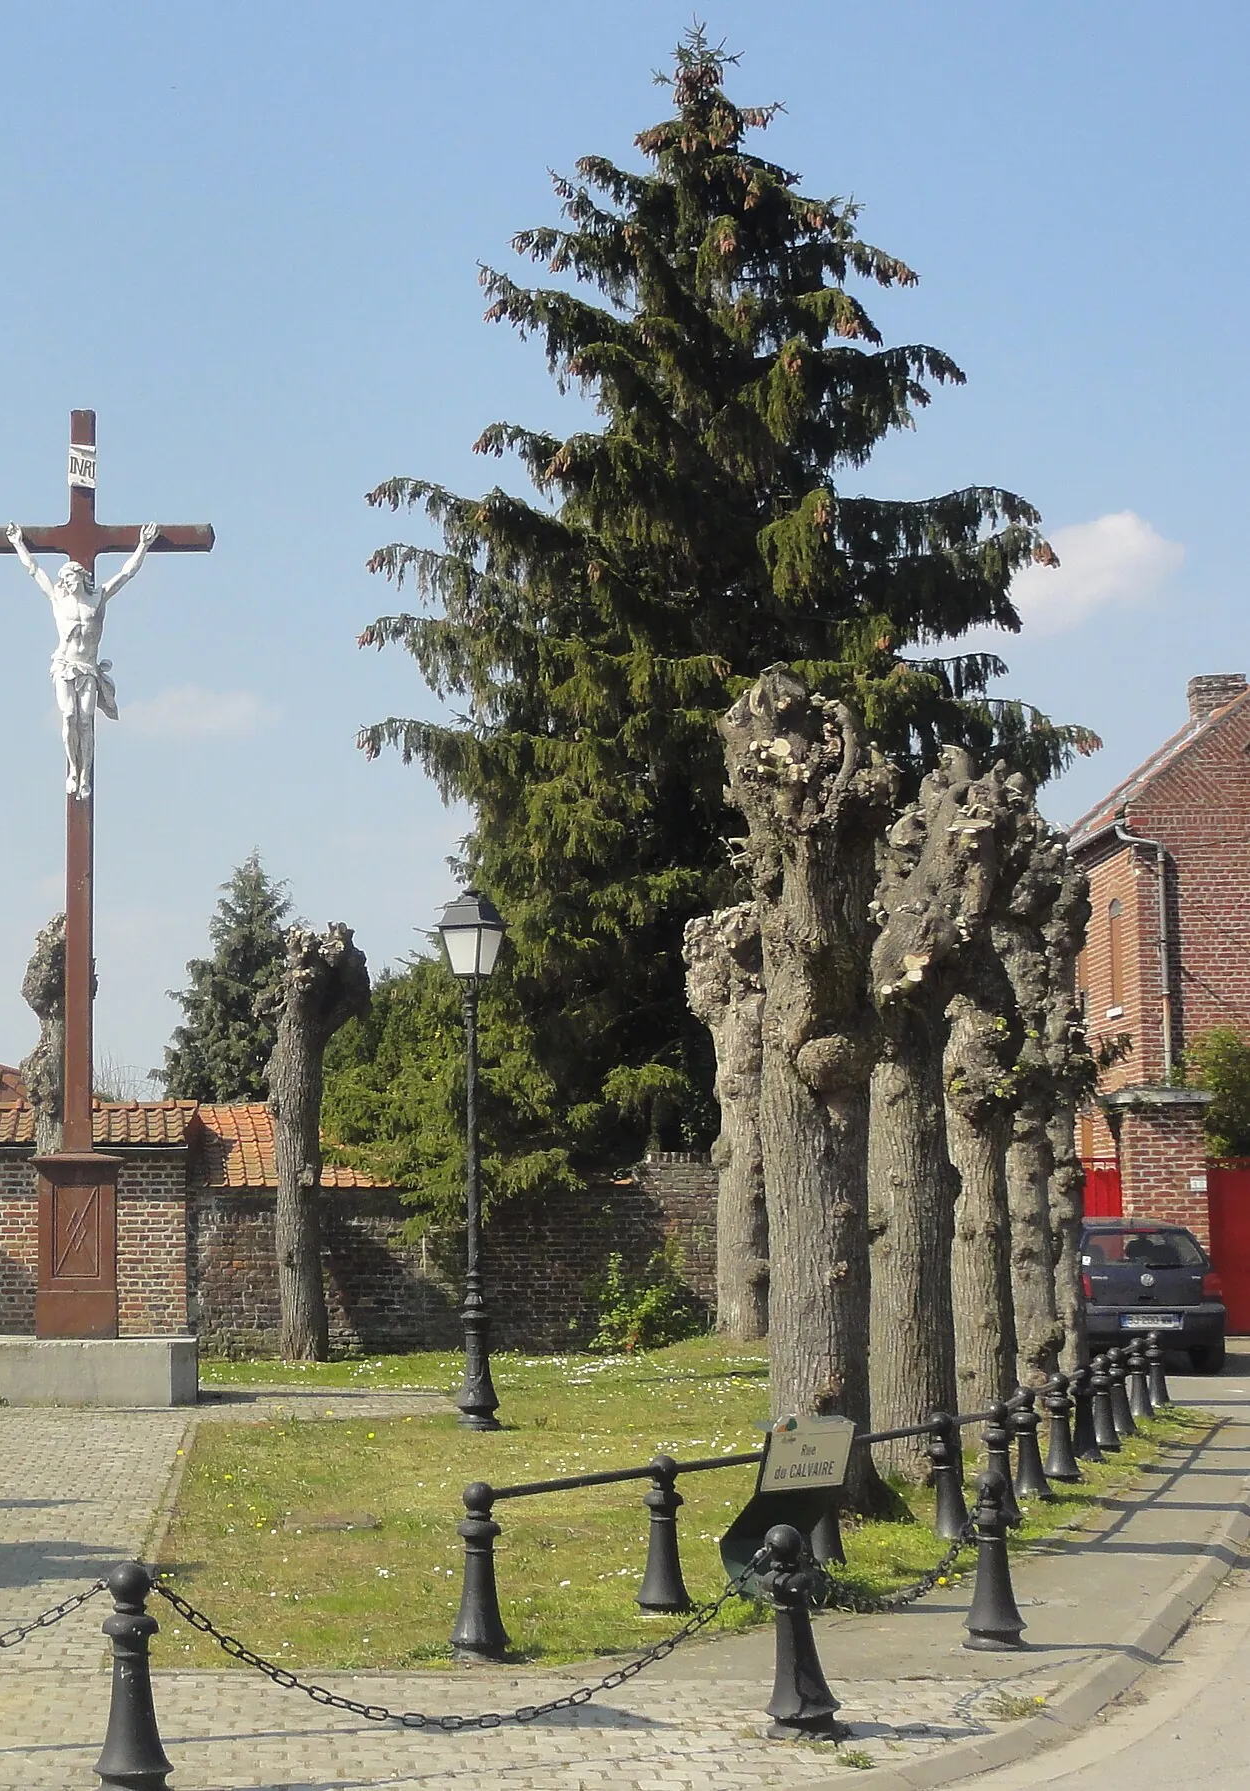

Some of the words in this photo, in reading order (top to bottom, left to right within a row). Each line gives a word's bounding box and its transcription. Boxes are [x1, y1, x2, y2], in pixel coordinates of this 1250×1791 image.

[70, 456, 96, 480] INRI
[800, 1443, 817, 1456] Rue
[774, 1465, 786, 1480] du
[789, 1461, 835, 1478] CALVAIRE
